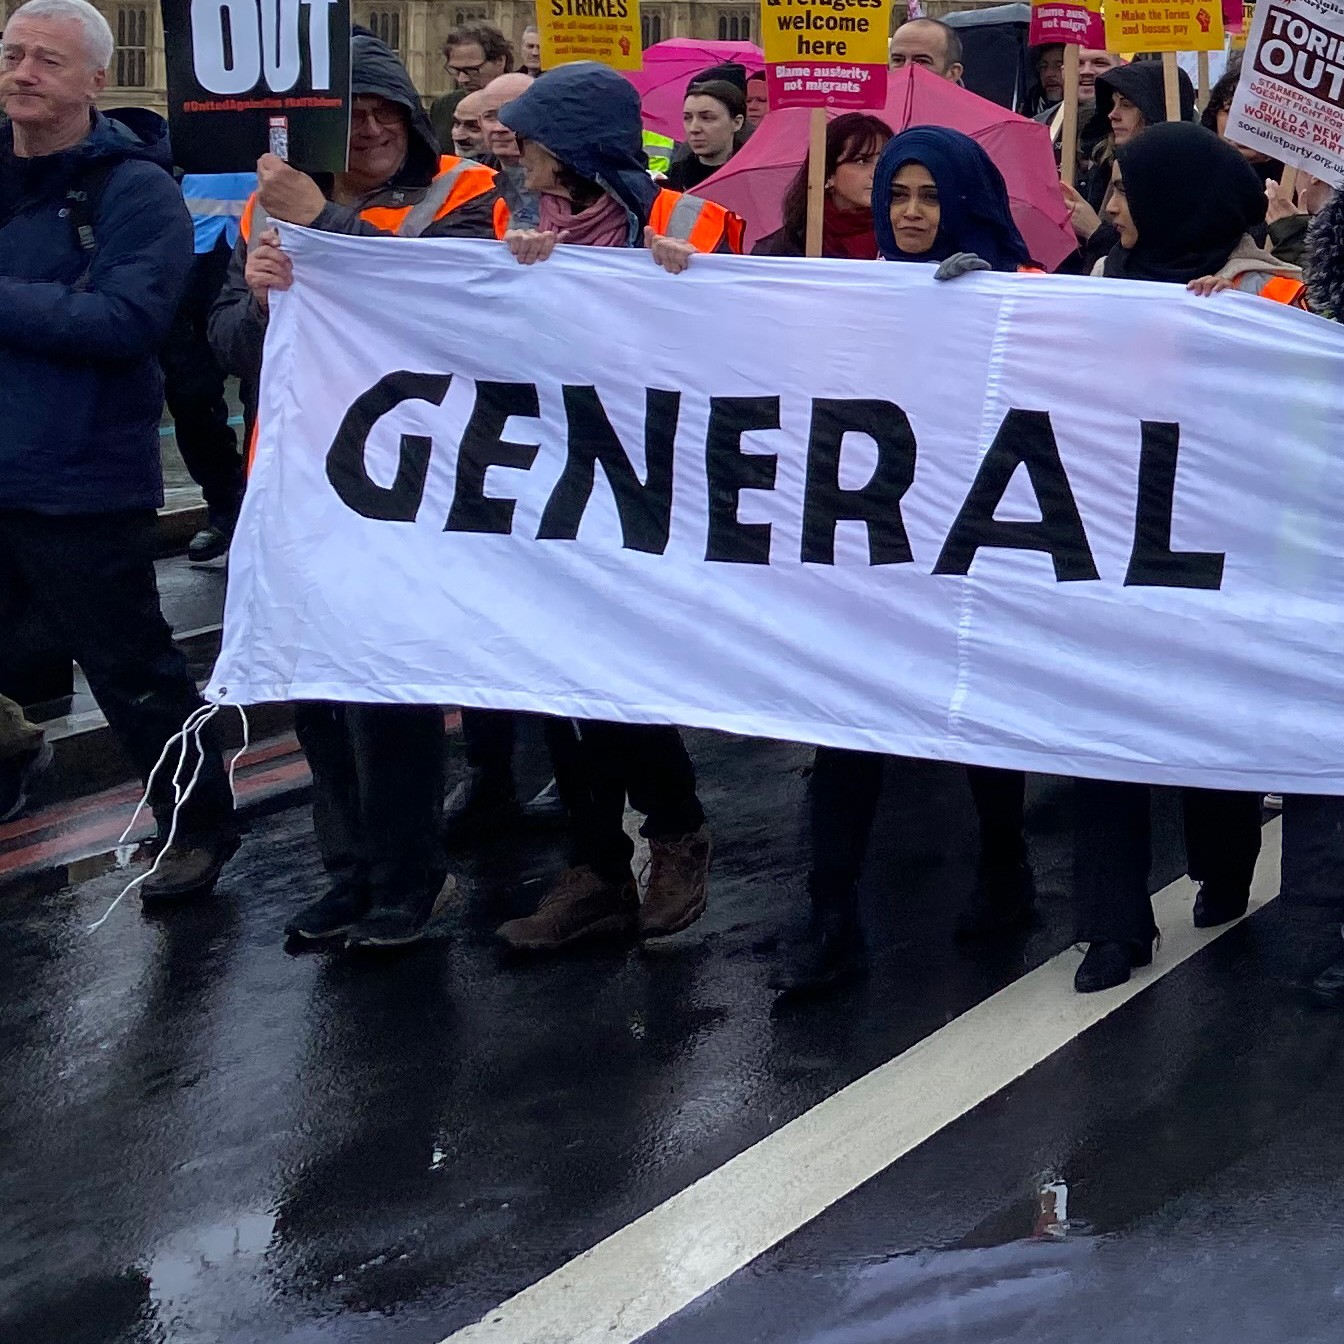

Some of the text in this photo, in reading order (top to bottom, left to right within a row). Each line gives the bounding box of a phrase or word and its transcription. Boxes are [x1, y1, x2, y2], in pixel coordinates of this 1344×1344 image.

[777, 10, 869, 32] welcome
[1121, 9, 1190, 21] Make the Tories
[1122, 23, 1188, 35] and bosses pay
[797, 35, 847, 55] here
[776, 65, 811, 77] Blame
[784, 79, 860, 94] not migrants
[1258, 77, 1312, 107] STARMER'S
[1250, 82, 1291, 108] DOESN'T
[1293, 101, 1322, 121] FIGHT
[1323, 114, 1343, 131] FOR
[1244, 104, 1311, 138] WORKERS'
[1260, 102, 1342, 143] BUILD A NEW
[1238, 121, 1344, 173] socialistparty.org.uk
[324, 369, 1225, 590] GENERAL
